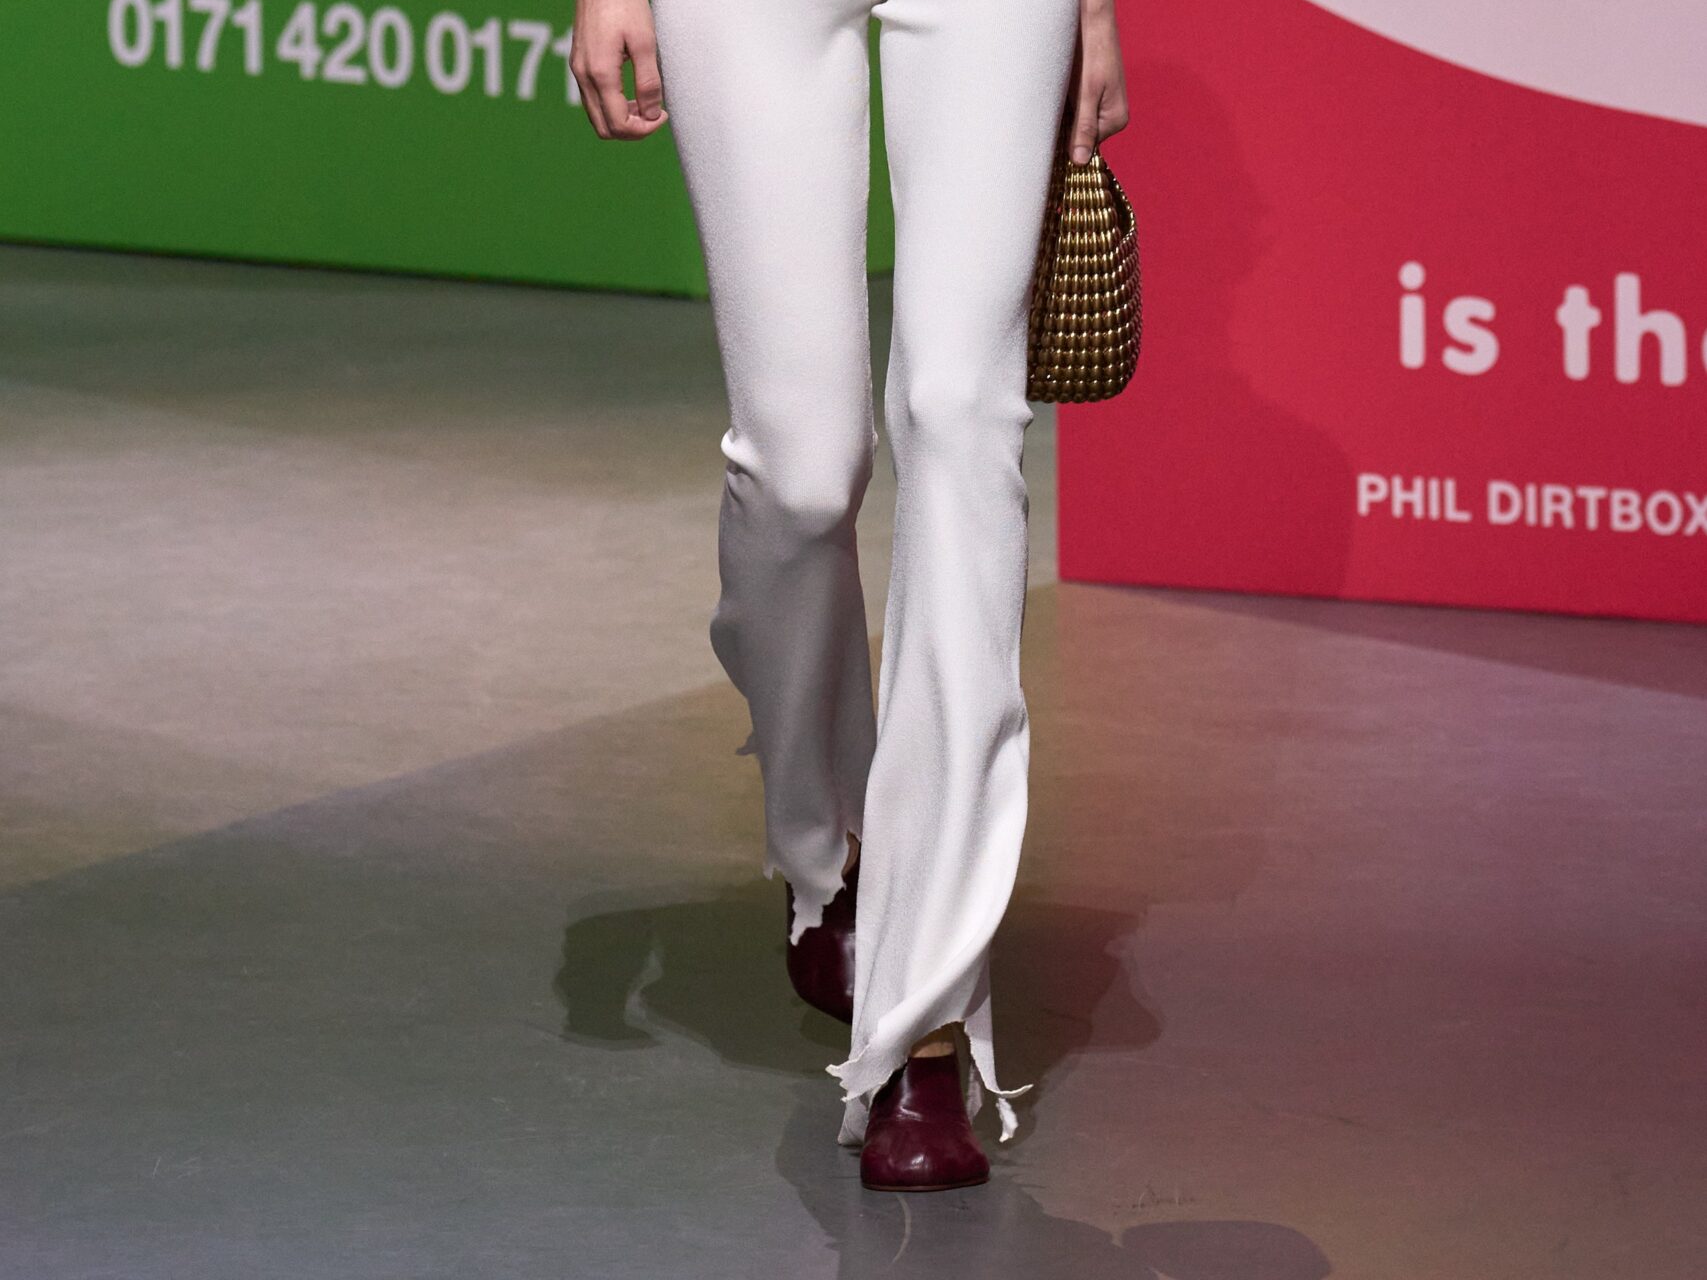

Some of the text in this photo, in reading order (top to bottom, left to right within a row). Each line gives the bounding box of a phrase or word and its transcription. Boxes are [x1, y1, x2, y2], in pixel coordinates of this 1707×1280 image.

[276, 0, 414, 89] 420
[1398, 260, 1707, 387] is th
[1356, 473, 1707, 536] PHIL DIRTBOX
